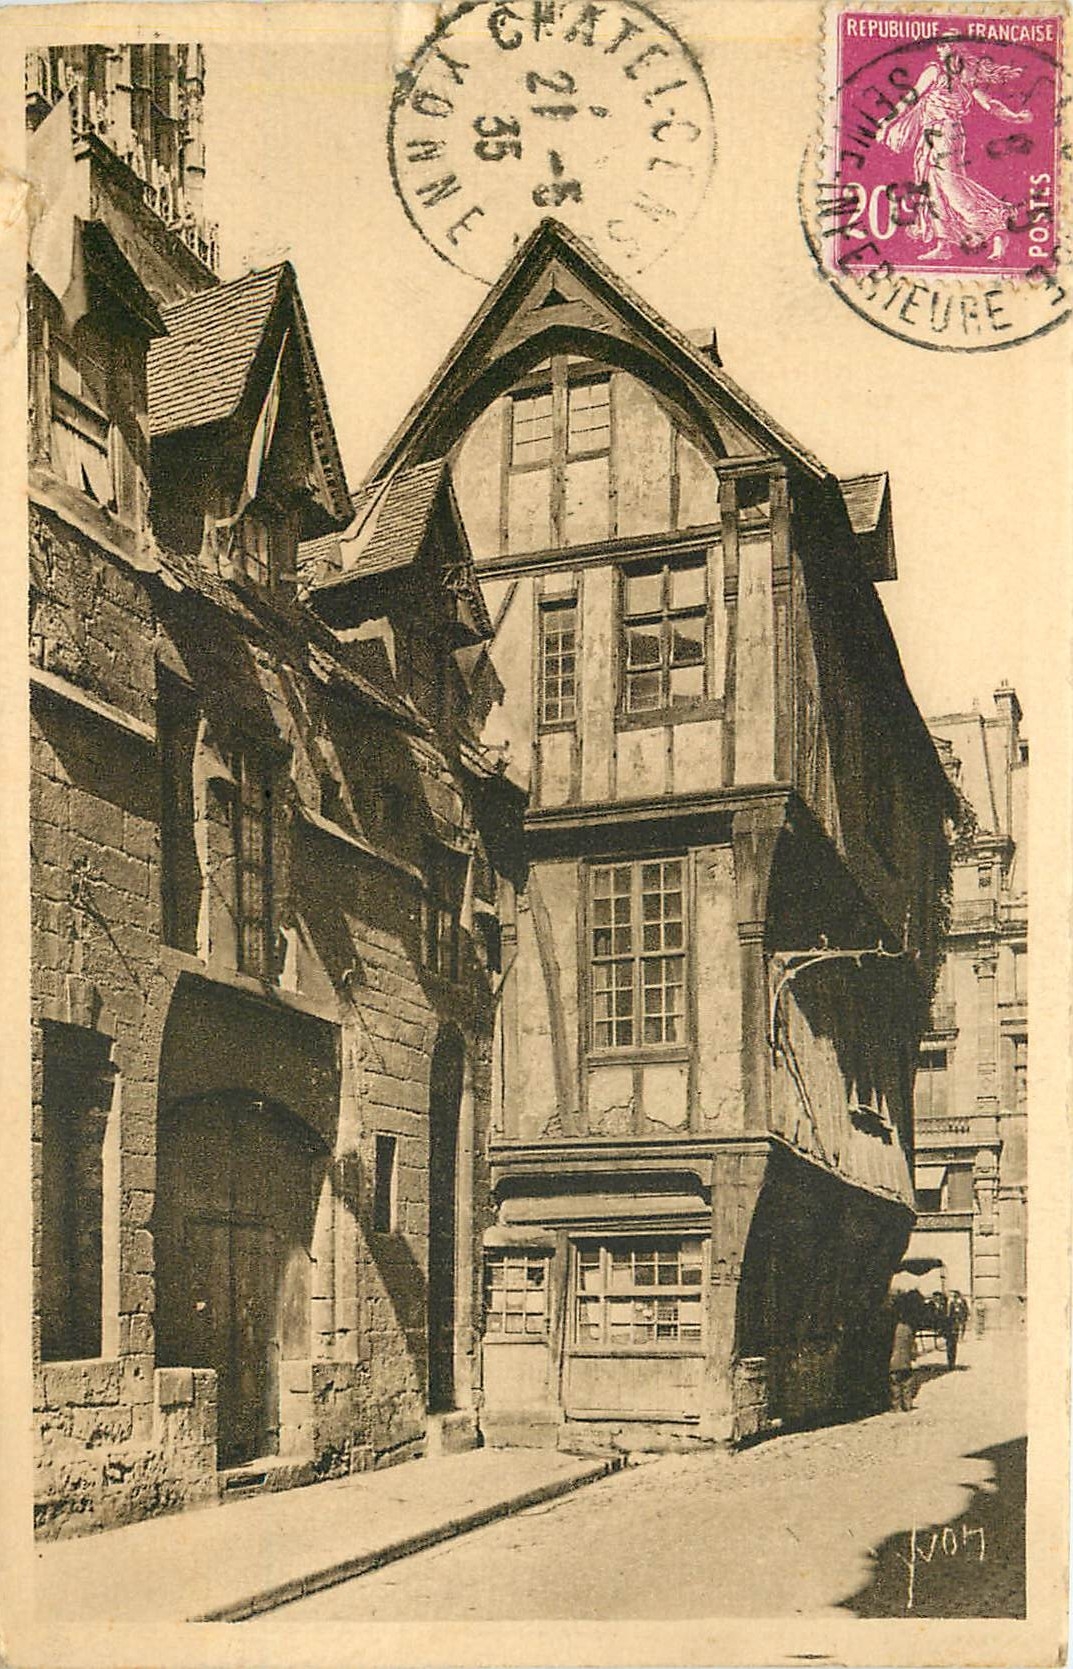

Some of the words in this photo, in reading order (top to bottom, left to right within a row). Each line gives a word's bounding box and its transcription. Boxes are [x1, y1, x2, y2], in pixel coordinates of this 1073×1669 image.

[846, 18, 940, 42] REPUBLIQUE
[967, 22, 1054, 42] FRANÇAISE
[1028, 173, 1052, 258] POSTES
